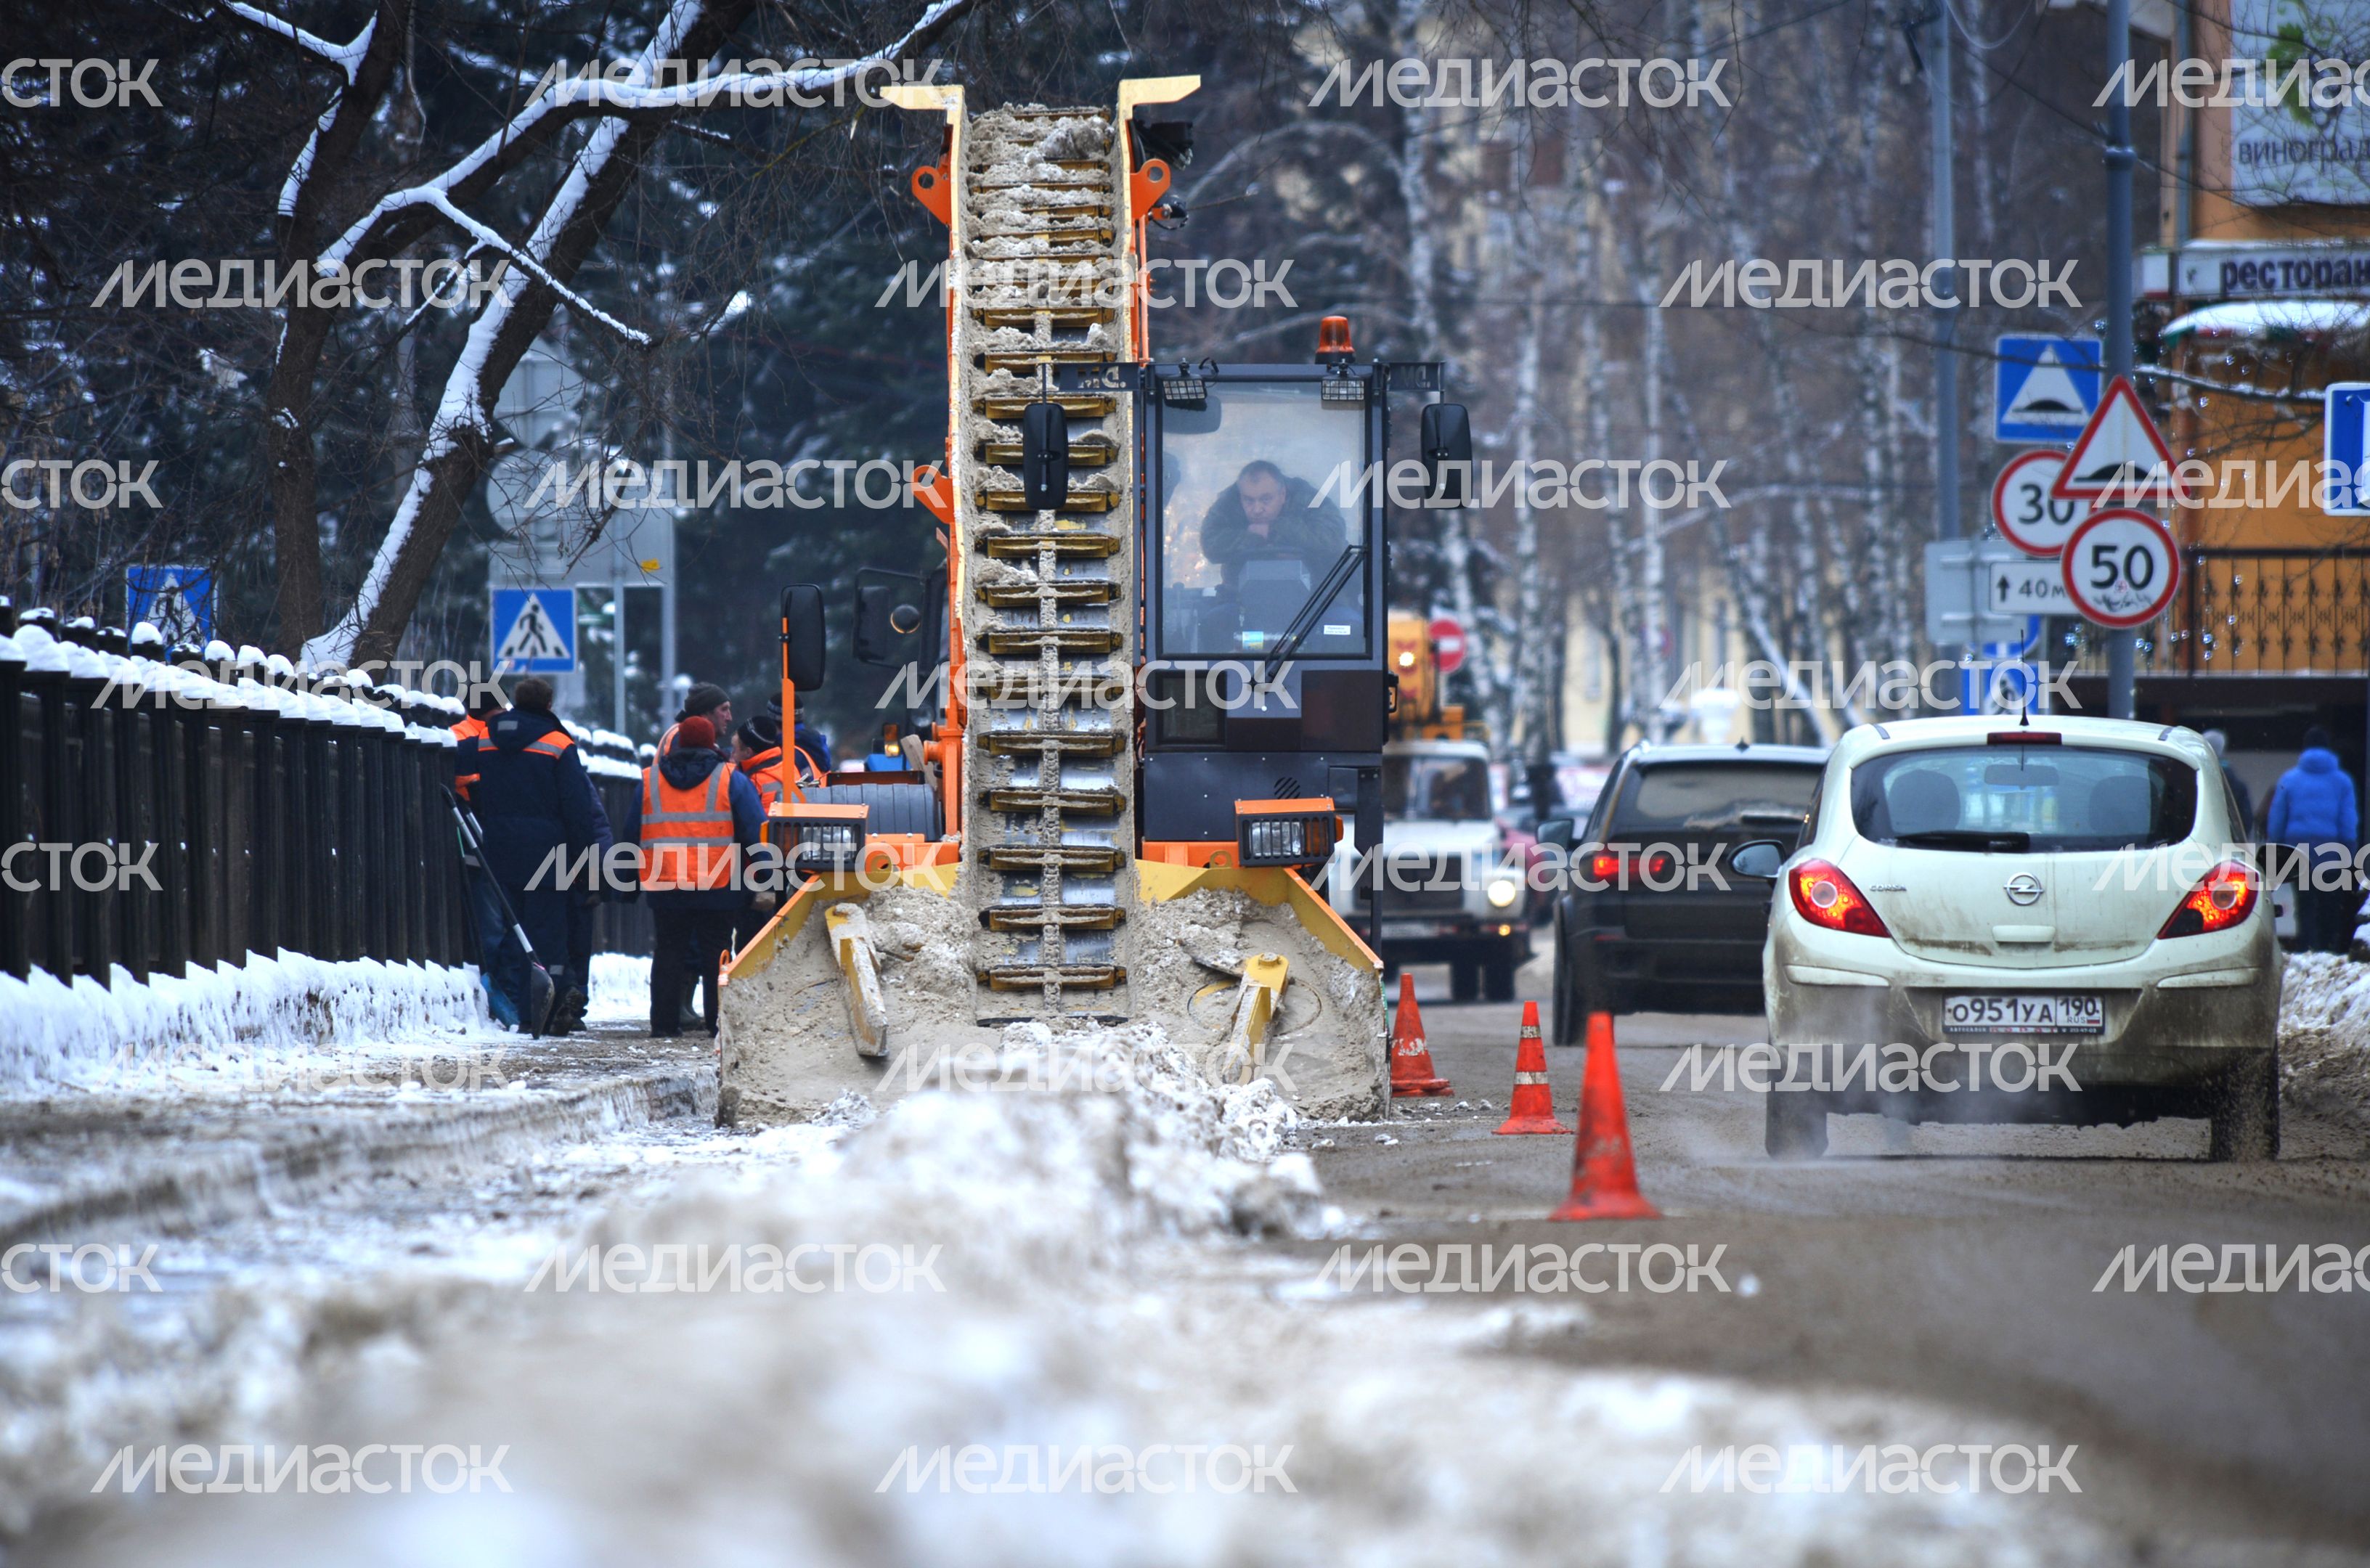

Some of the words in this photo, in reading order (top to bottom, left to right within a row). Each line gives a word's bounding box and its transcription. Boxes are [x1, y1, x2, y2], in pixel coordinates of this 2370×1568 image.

[2018, 483, 2074, 526] 30
[2090, 545, 2154, 591] 50
[2060, 998, 2096, 1016] 190
